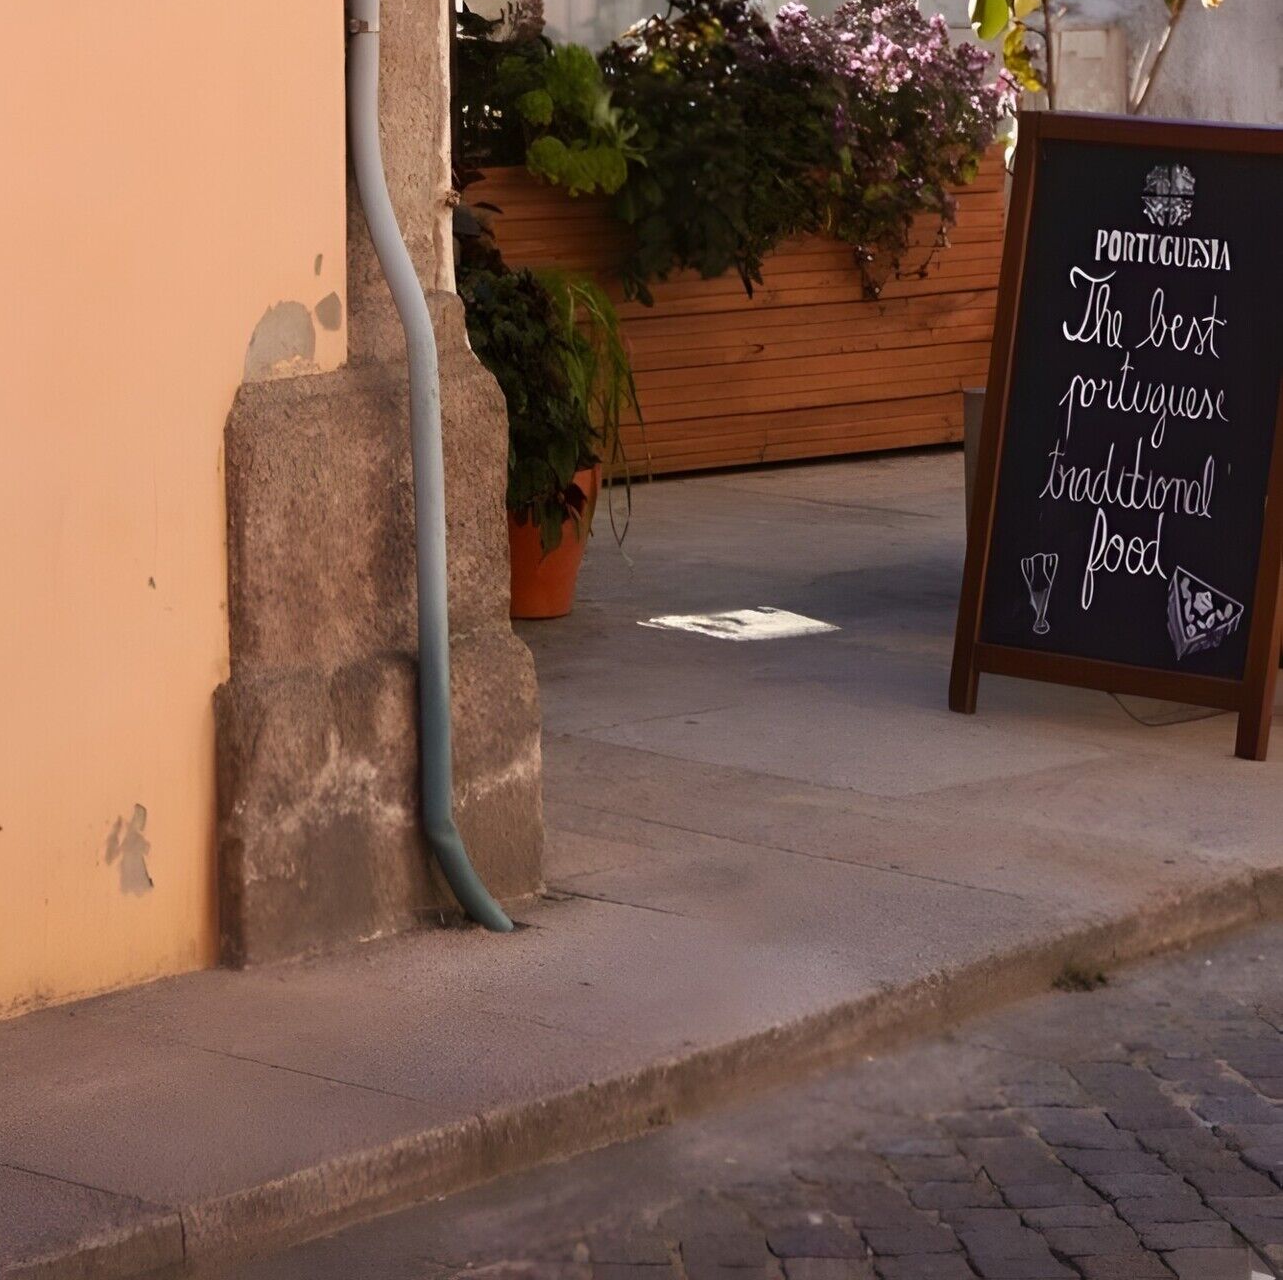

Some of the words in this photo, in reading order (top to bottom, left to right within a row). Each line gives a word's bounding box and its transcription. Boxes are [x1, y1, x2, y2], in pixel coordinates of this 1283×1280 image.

[1094, 228, 1231, 271] PORTUGUESIA
[1062, 265, 1123, 349] The
[1135, 287, 1228, 359] best
[1058, 351, 1230, 449] portuguese
[1038, 436, 1216, 519] traditional
[1081, 507, 1168, 611] food
